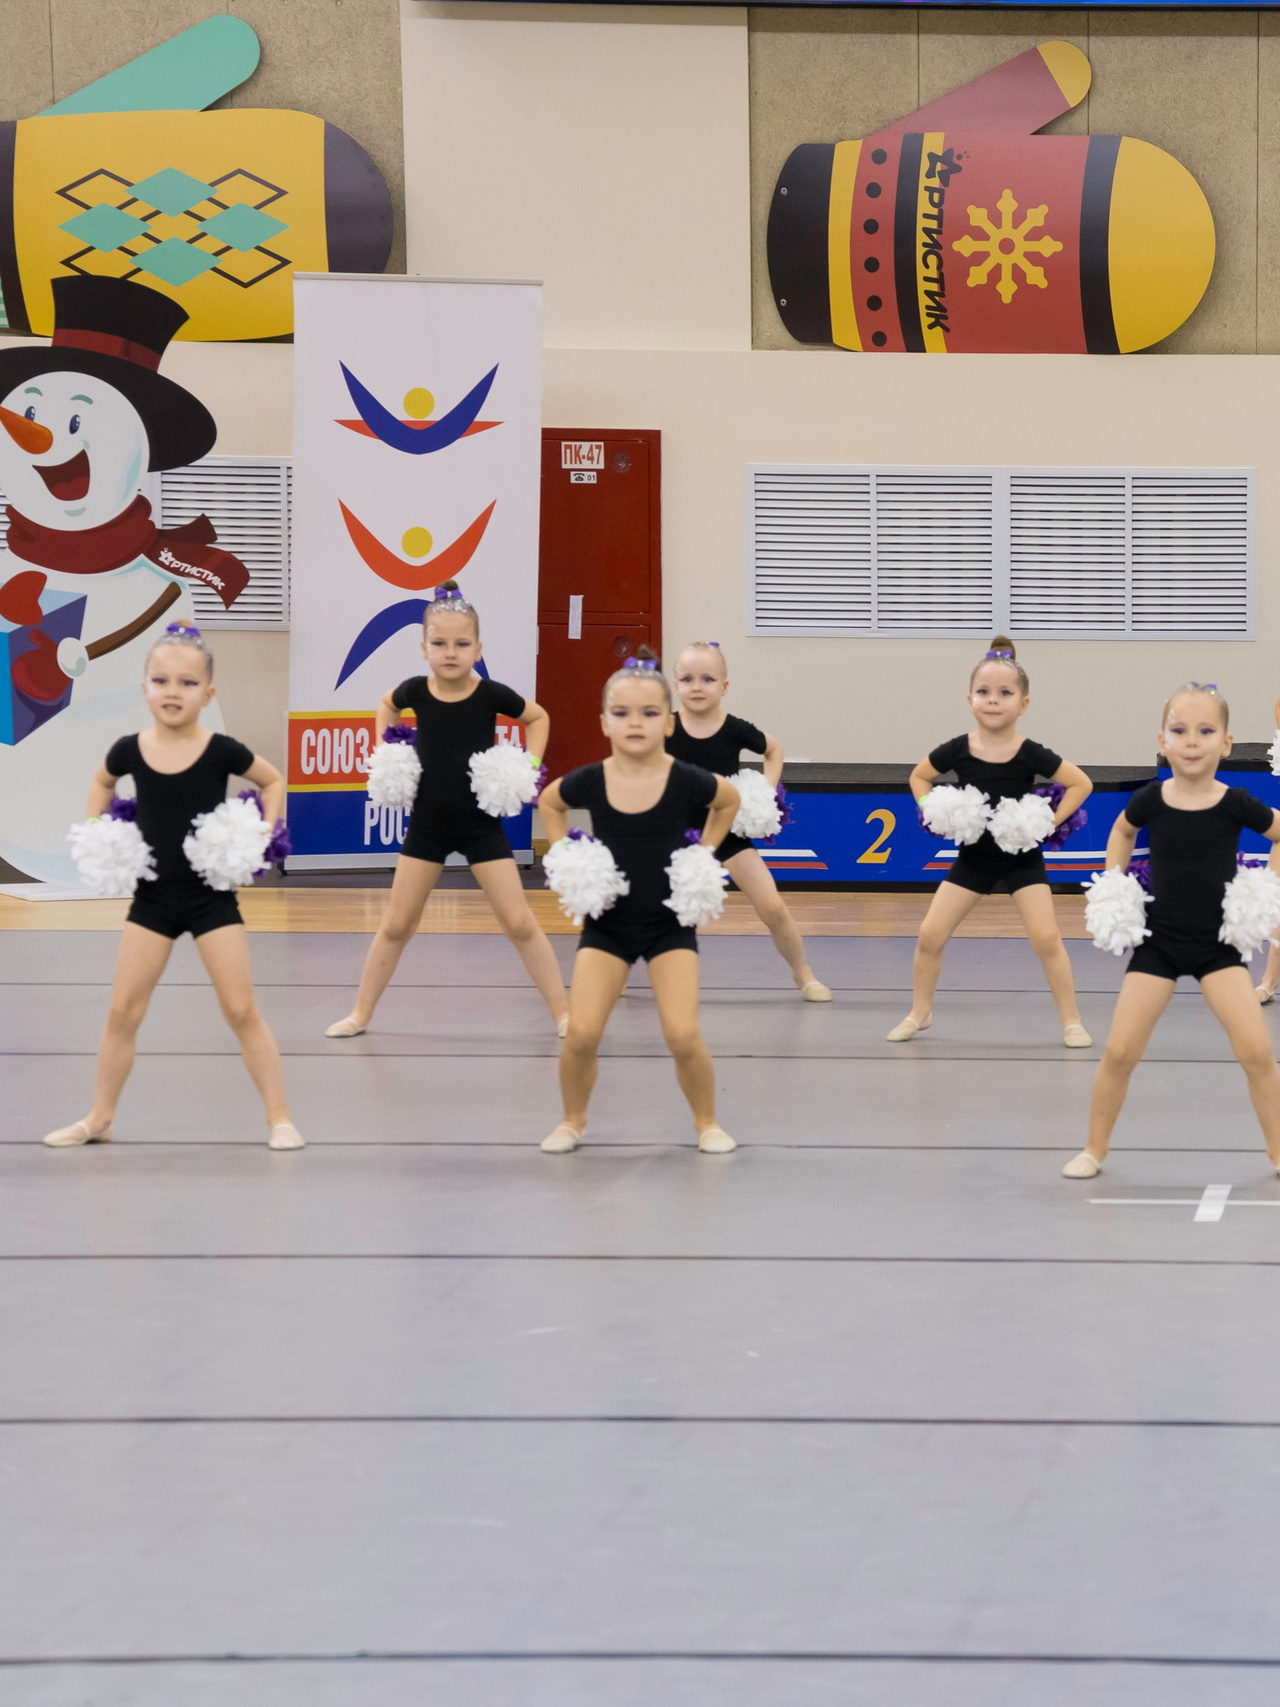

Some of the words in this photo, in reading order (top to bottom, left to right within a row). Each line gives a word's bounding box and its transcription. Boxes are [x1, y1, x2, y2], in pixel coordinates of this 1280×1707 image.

[563, 444, 603, 465] ПК-47
[301, 727, 370, 775] СОЮЗ
[364, 800, 411, 846] РОС
[856, 808, 896, 864] 2
